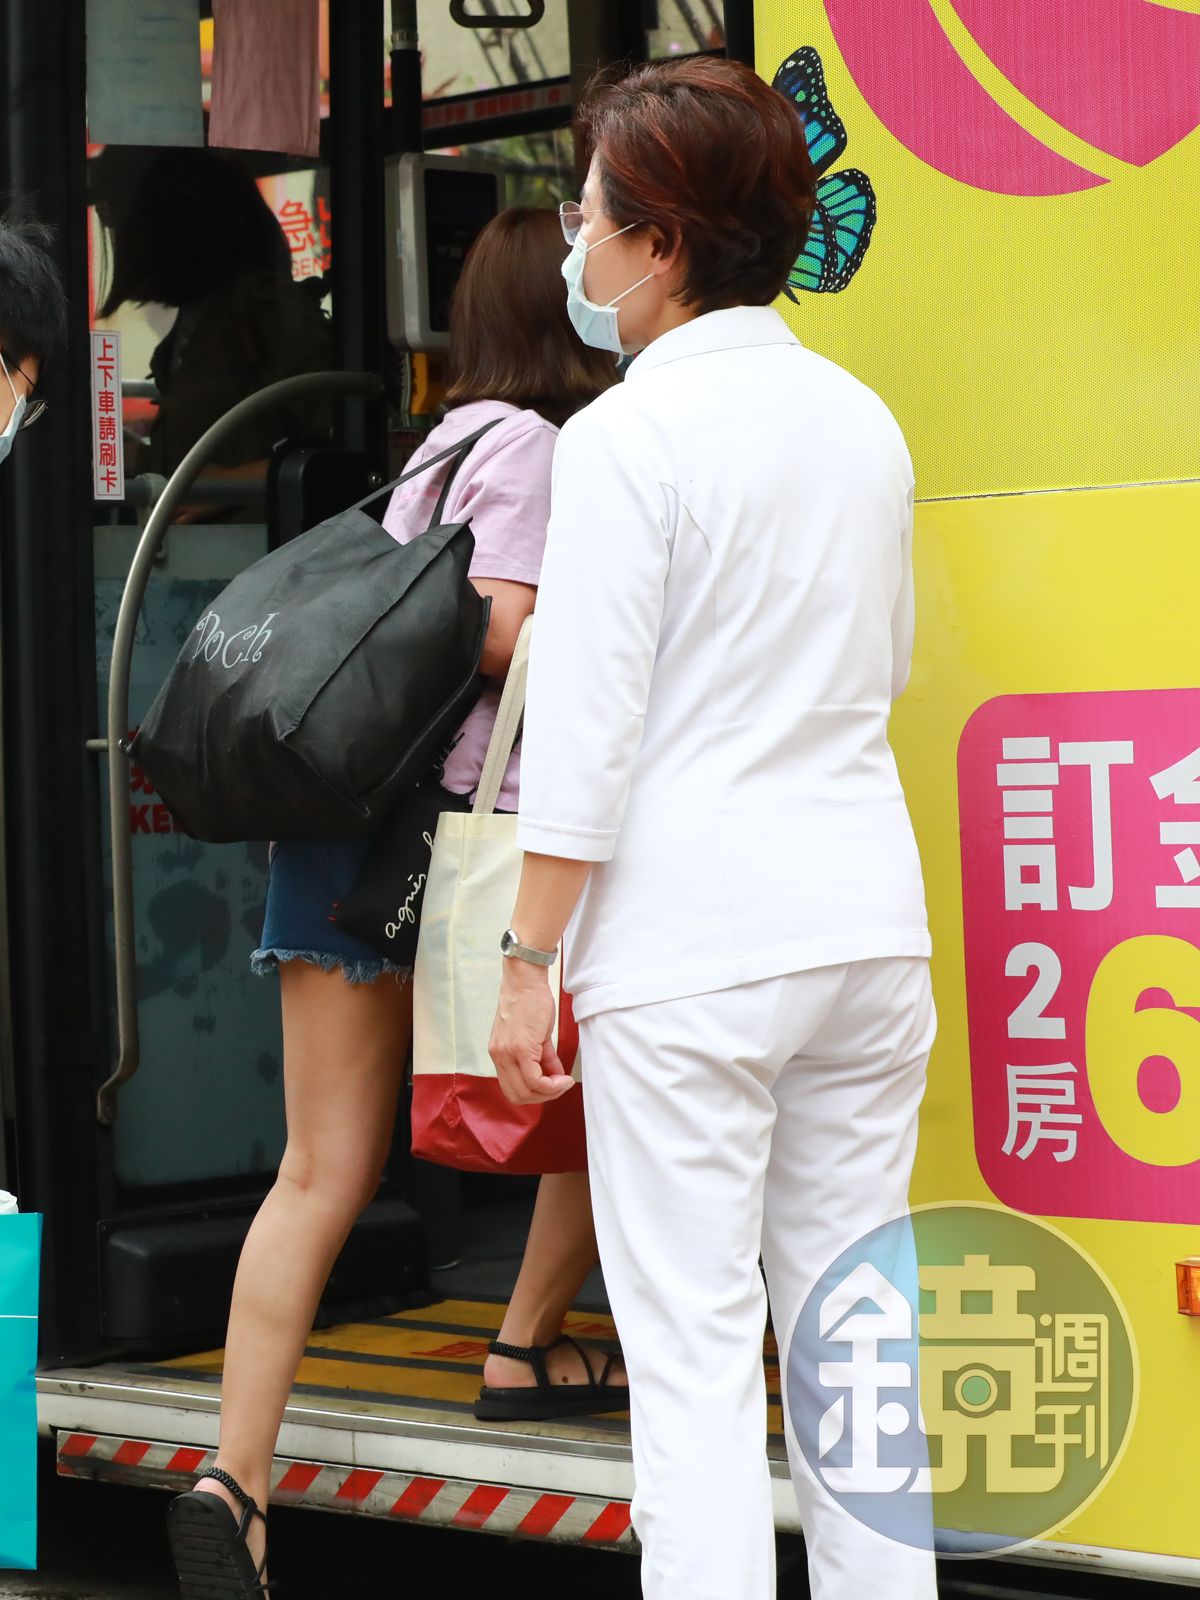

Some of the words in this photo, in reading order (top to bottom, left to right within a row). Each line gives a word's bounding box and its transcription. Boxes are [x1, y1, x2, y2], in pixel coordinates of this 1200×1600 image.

[97, 338, 118, 493] 上下車請刷卡
